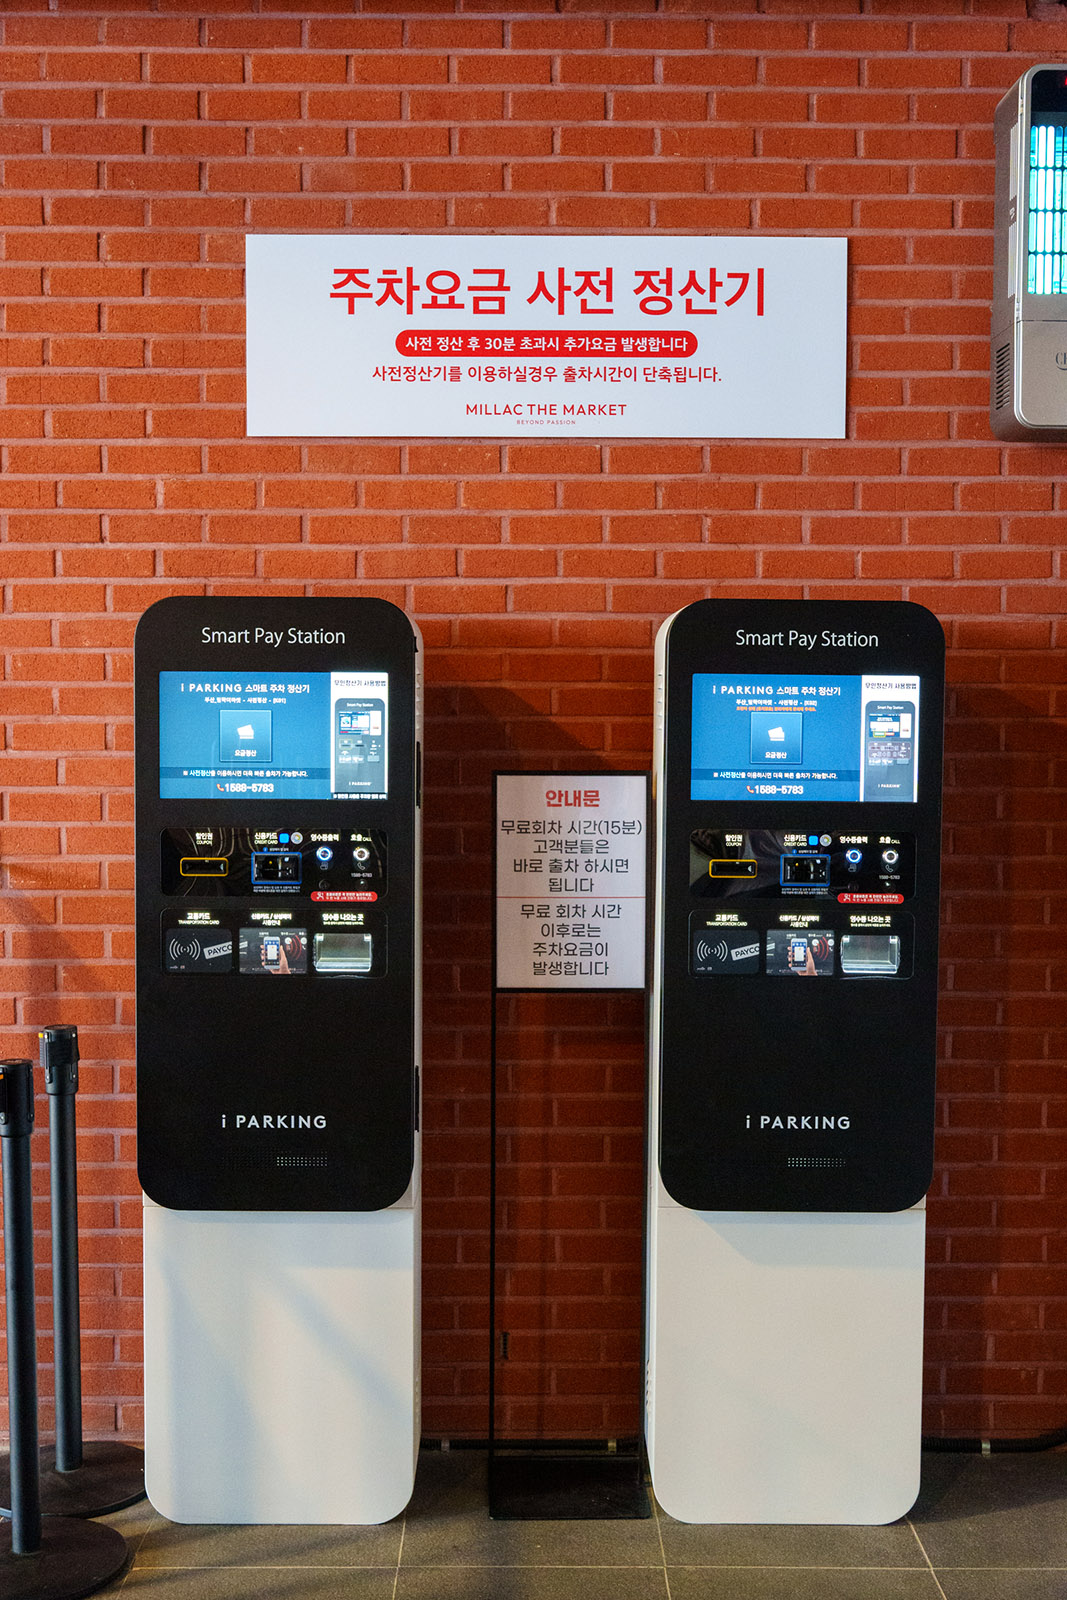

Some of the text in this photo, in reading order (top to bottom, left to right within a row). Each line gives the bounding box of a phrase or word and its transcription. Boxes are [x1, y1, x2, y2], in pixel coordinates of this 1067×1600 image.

[329, 266, 765, 317] 주차요금 사전 정산기
[405, 336, 688, 352] 사전 정산 후 30분 초과시 추가요금 발생합니다
[372, 366, 722, 383] 사전정산기를 이용하실경우 출차시간이 단축됩니다.
[466, 404, 627, 416] MILLAC THE MARKET
[202, 628, 346, 648] Smart Pay Station
[736, 630, 879, 650] Smart Pay Station
[189, 684, 242, 692] PARKING
[245, 684, 268, 692] 스마트
[270, 684, 285, 692] 주차
[287, 684, 310, 693] 정산기
[721, 686, 773, 694] PARKING
[776, 686, 799, 695] 스마트
[801, 686, 816, 695] 주차
[818, 687, 841, 696] 정산기
[224, 783, 274, 792] 1588-5783
[754, 785, 804, 794] 1588-5783
[545, 790, 600, 808] 안내문
[500, 820, 642, 835] 무료회차 시간(15분)
[533, 840, 610, 854] 고객분들은
[514, 859, 629, 873] 바로 출차 하시면
[548, 878, 594, 892] 됩니다
[520, 904, 622, 919] 무료 회차 시간
[541, 923, 601, 937] 이후로는
[207, 944, 232, 955] PAYCO
[532, 942, 608, 957] 주차요금이
[533, 961, 609, 976] 발생합니다
[222, 1114, 326, 1129] i PARKING
[746, 1115, 850, 1129] i PARKING
